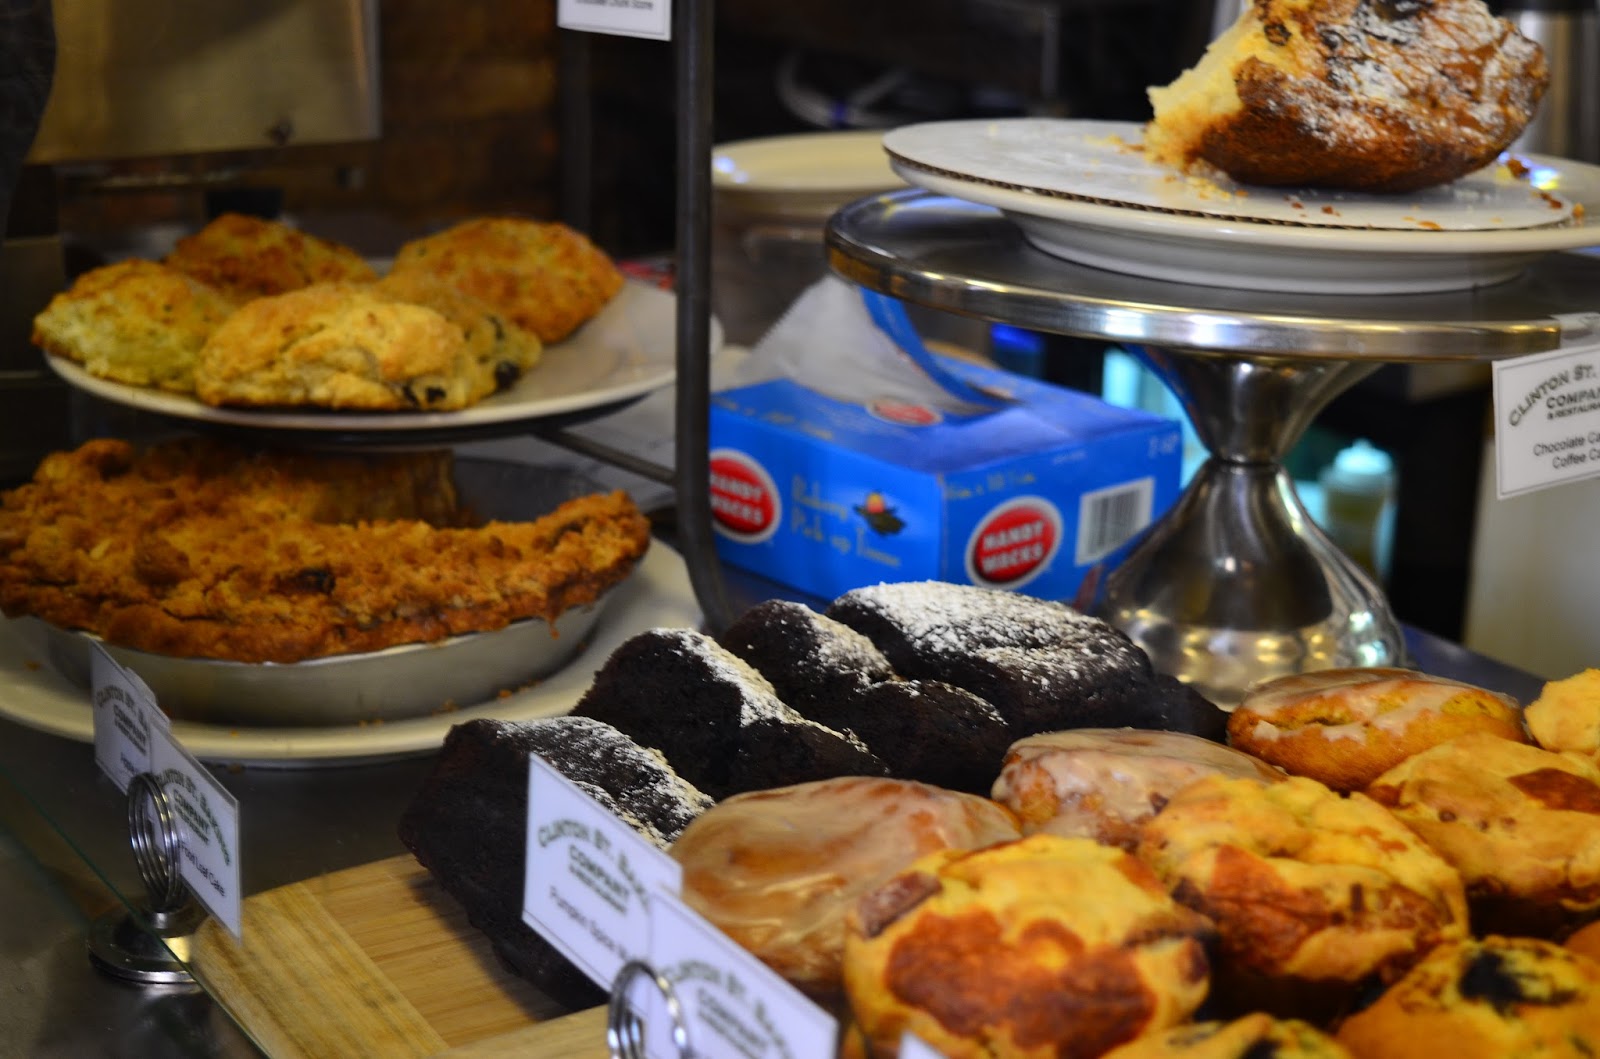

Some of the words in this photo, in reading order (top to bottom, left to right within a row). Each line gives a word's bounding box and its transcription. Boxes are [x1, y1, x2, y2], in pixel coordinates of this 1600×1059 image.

[1508, 370, 1570, 427] CLINTON
[1574, 364, 1597, 381] ST.
[1533, 436, 1585, 456] Chocolate
[1552, 453, 1586, 469] Coffee
[983, 520, 1045, 550] HANDY
